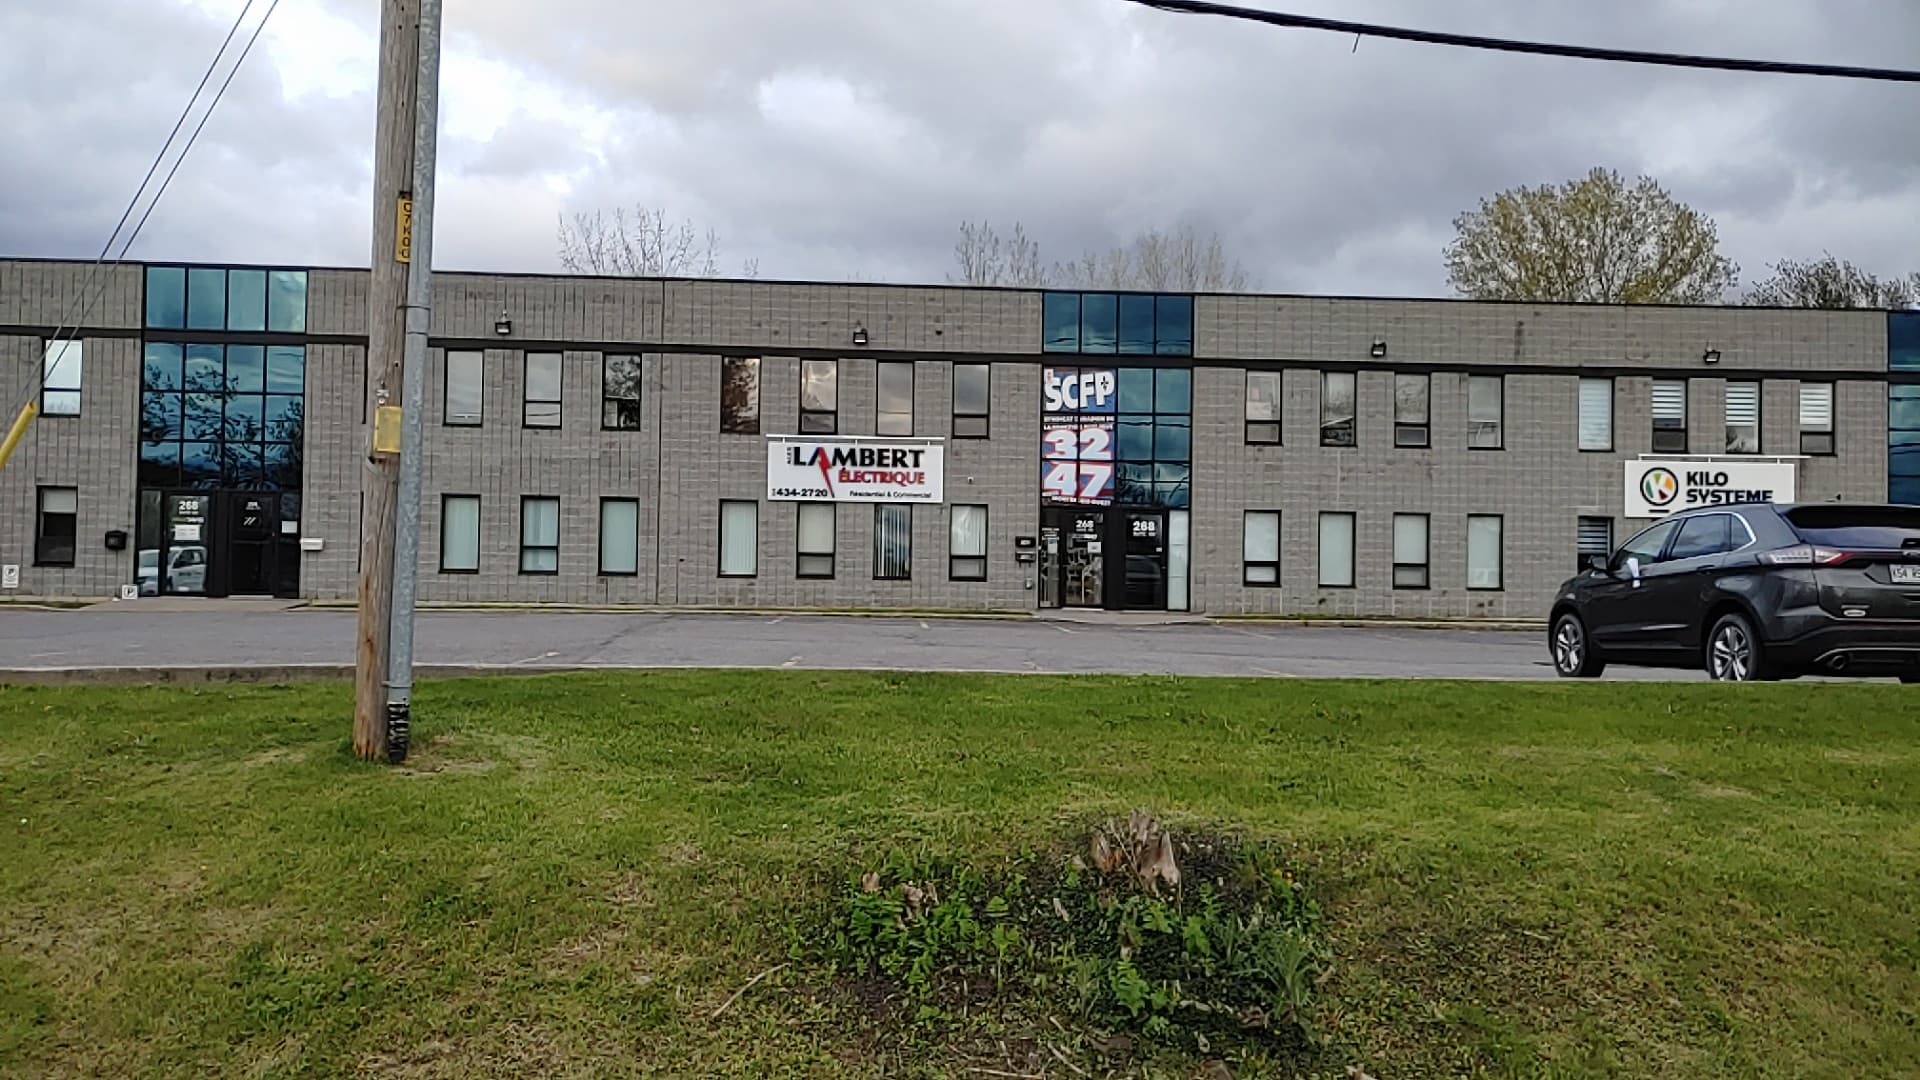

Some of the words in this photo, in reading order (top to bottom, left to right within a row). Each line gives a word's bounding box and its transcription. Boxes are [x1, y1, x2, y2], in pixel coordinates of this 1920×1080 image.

[1044, 371, 1115, 411] SCFP
[1044, 428, 1112, 459] 32
[793, 446, 925, 468] LAMBERT
[838, 468, 925, 486] ÉLECTRIQUE
[1043, 462, 1112, 496] 47
[1686, 471, 1729, 486] KILO
[776, 488, 828, 497] 434-2720
[1685, 489, 1773, 503] SYSTEME
